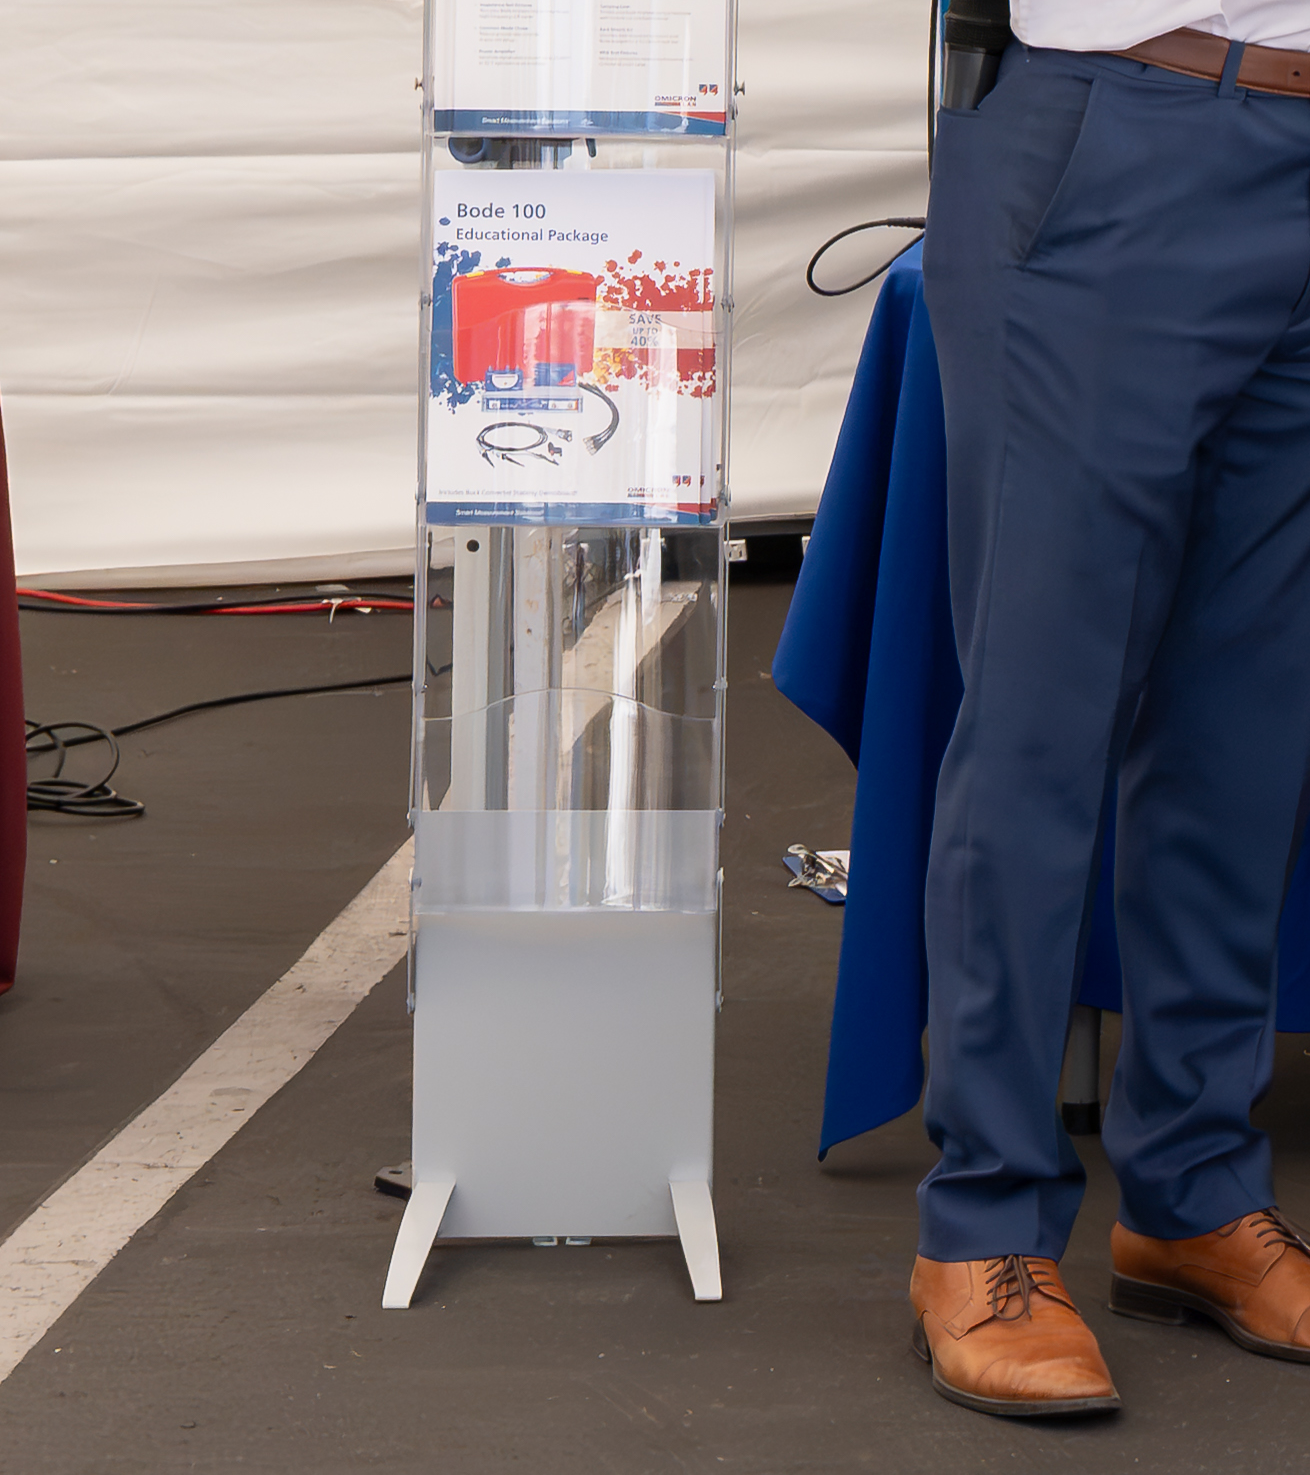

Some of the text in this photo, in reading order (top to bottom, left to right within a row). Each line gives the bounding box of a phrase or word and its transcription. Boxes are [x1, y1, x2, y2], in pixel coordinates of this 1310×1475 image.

[457, 203, 546, 219] Bode 100
[456, 228, 609, 244] Educational Package
